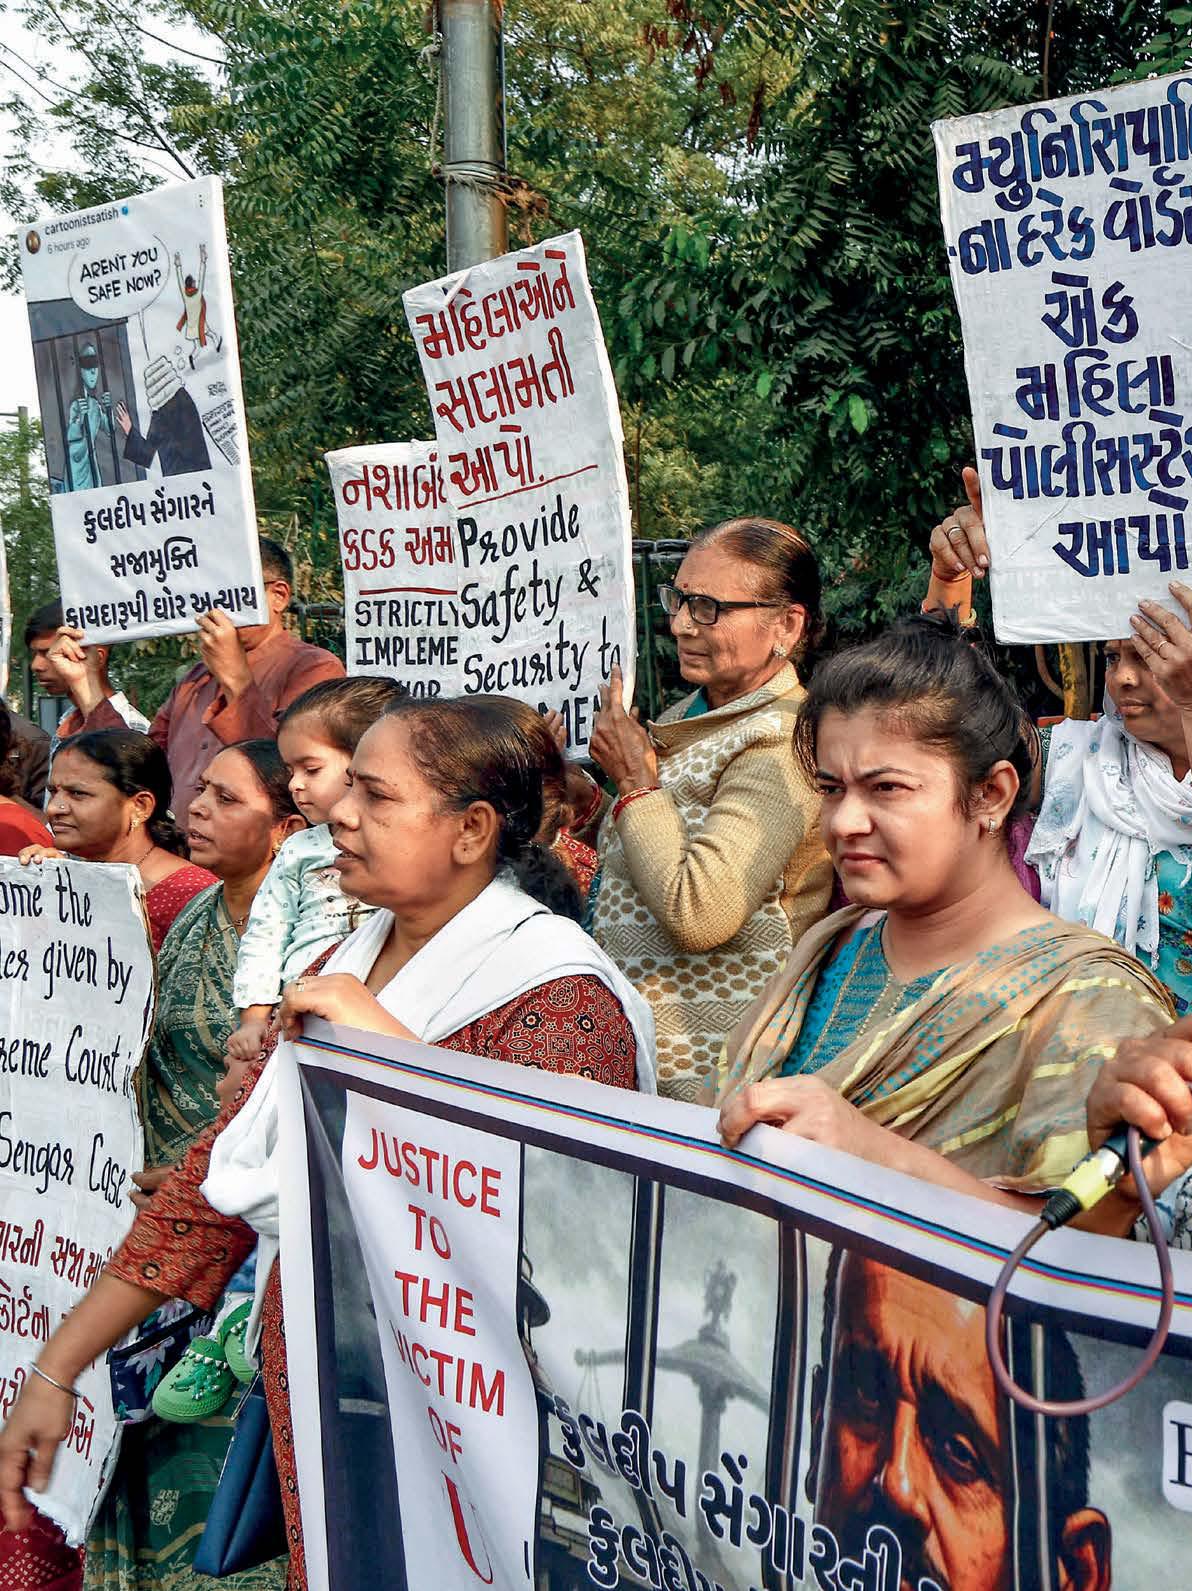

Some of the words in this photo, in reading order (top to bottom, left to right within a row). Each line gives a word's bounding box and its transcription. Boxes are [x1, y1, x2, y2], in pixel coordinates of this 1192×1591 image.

[45, 206, 119, 236] cartoonistsatish
[54, 239, 75, 253] hours
[76, 236, 90, 251] ago
[88, 280, 121, 304] SAFE
[126, 269, 162, 295] NOW?
[131, 247, 158, 269] YOU
[1041, 271, 1139, 348] એક
[436, 327, 575, 432] સલામતી
[1016, 348, 1174, 421] મહિલા
[83, 496, 146, 544] કુલદીપ
[150, 481, 215, 524] સેંગારને
[457, 495, 579, 568] Provide
[1052, 489, 1188, 577] આપો
[110, 535, 198, 583] સજામુક્તિ
[343, 528, 395, 570] કડક
[405, 526, 456, 566] અમ
[153, 586, 187, 620] ઘોર
[355, 599, 458, 627] STRICTLY
[461, 559, 562, 643] Safety
[578, 559, 600, 598] &
[356, 636, 458, 667] IMPLEME
[464, 620, 589, 694] Security
[0, 881, 43, 917] ome
[55, 866, 92, 927] the
[43, 940, 97, 1000] given
[107, 936, 133, 1005] by
[65, 1025, 121, 1093] Court
[0, 1111, 74, 1194] Sengar
[89, 1132, 126, 1209] Case
[358, 1127, 502, 1218] JUSTICE
[408, 1203, 451, 1260] TO
[395, 1270, 476, 1337] THE
[428, 1405, 463, 1465] OF
[553, 1394, 686, 1519] કુલદીપ
